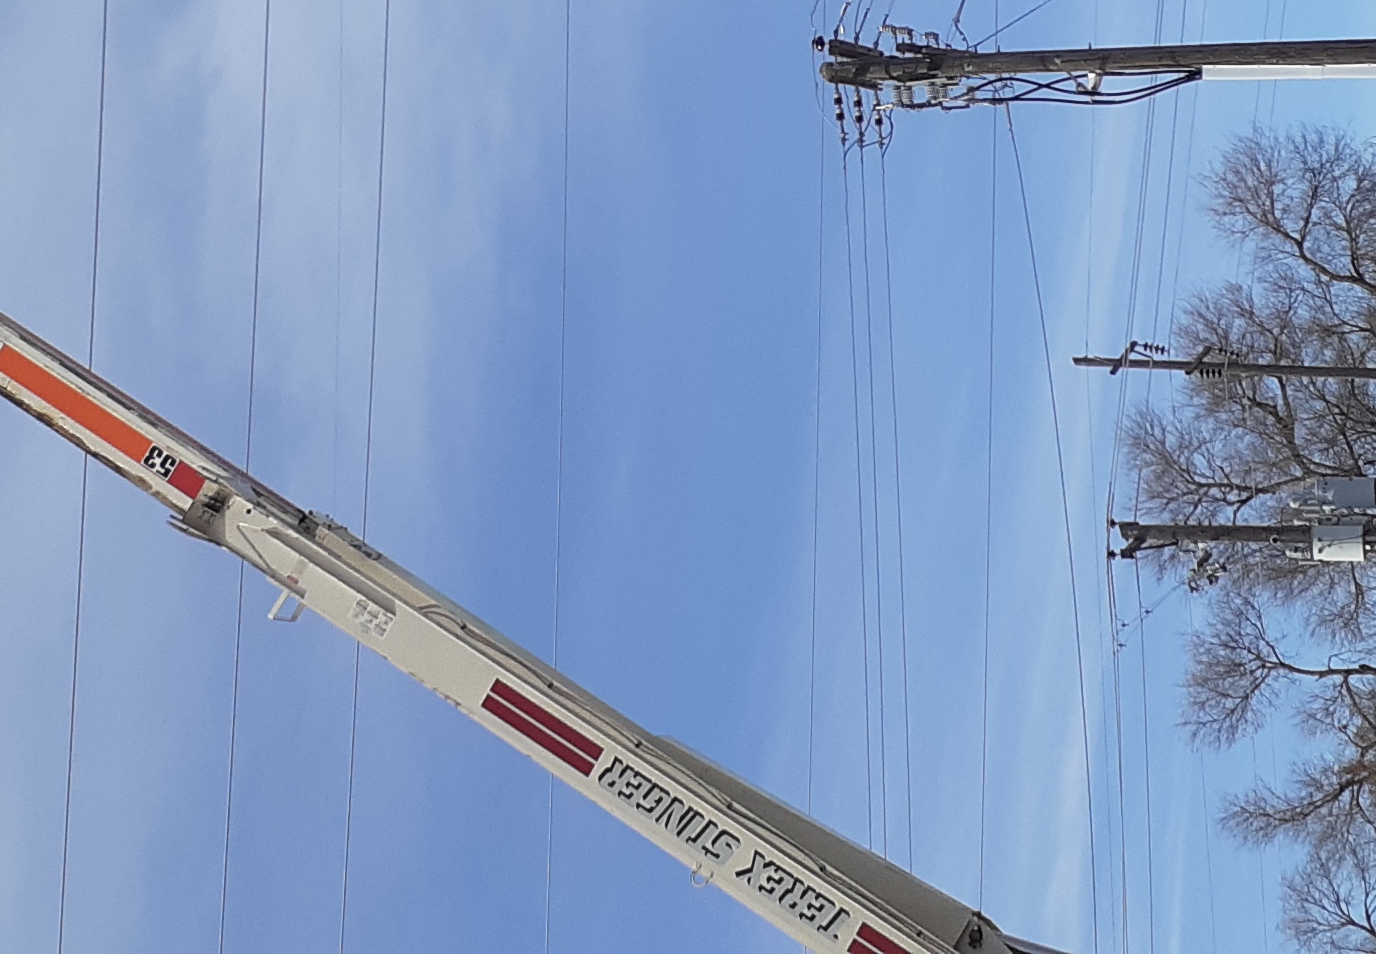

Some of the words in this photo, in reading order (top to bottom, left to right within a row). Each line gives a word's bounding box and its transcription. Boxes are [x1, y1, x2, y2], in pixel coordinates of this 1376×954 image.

[143, 444, 178, 479] 53
[597, 756, 743, 866] STINGER
[735, 850, 853, 944] TEREX
